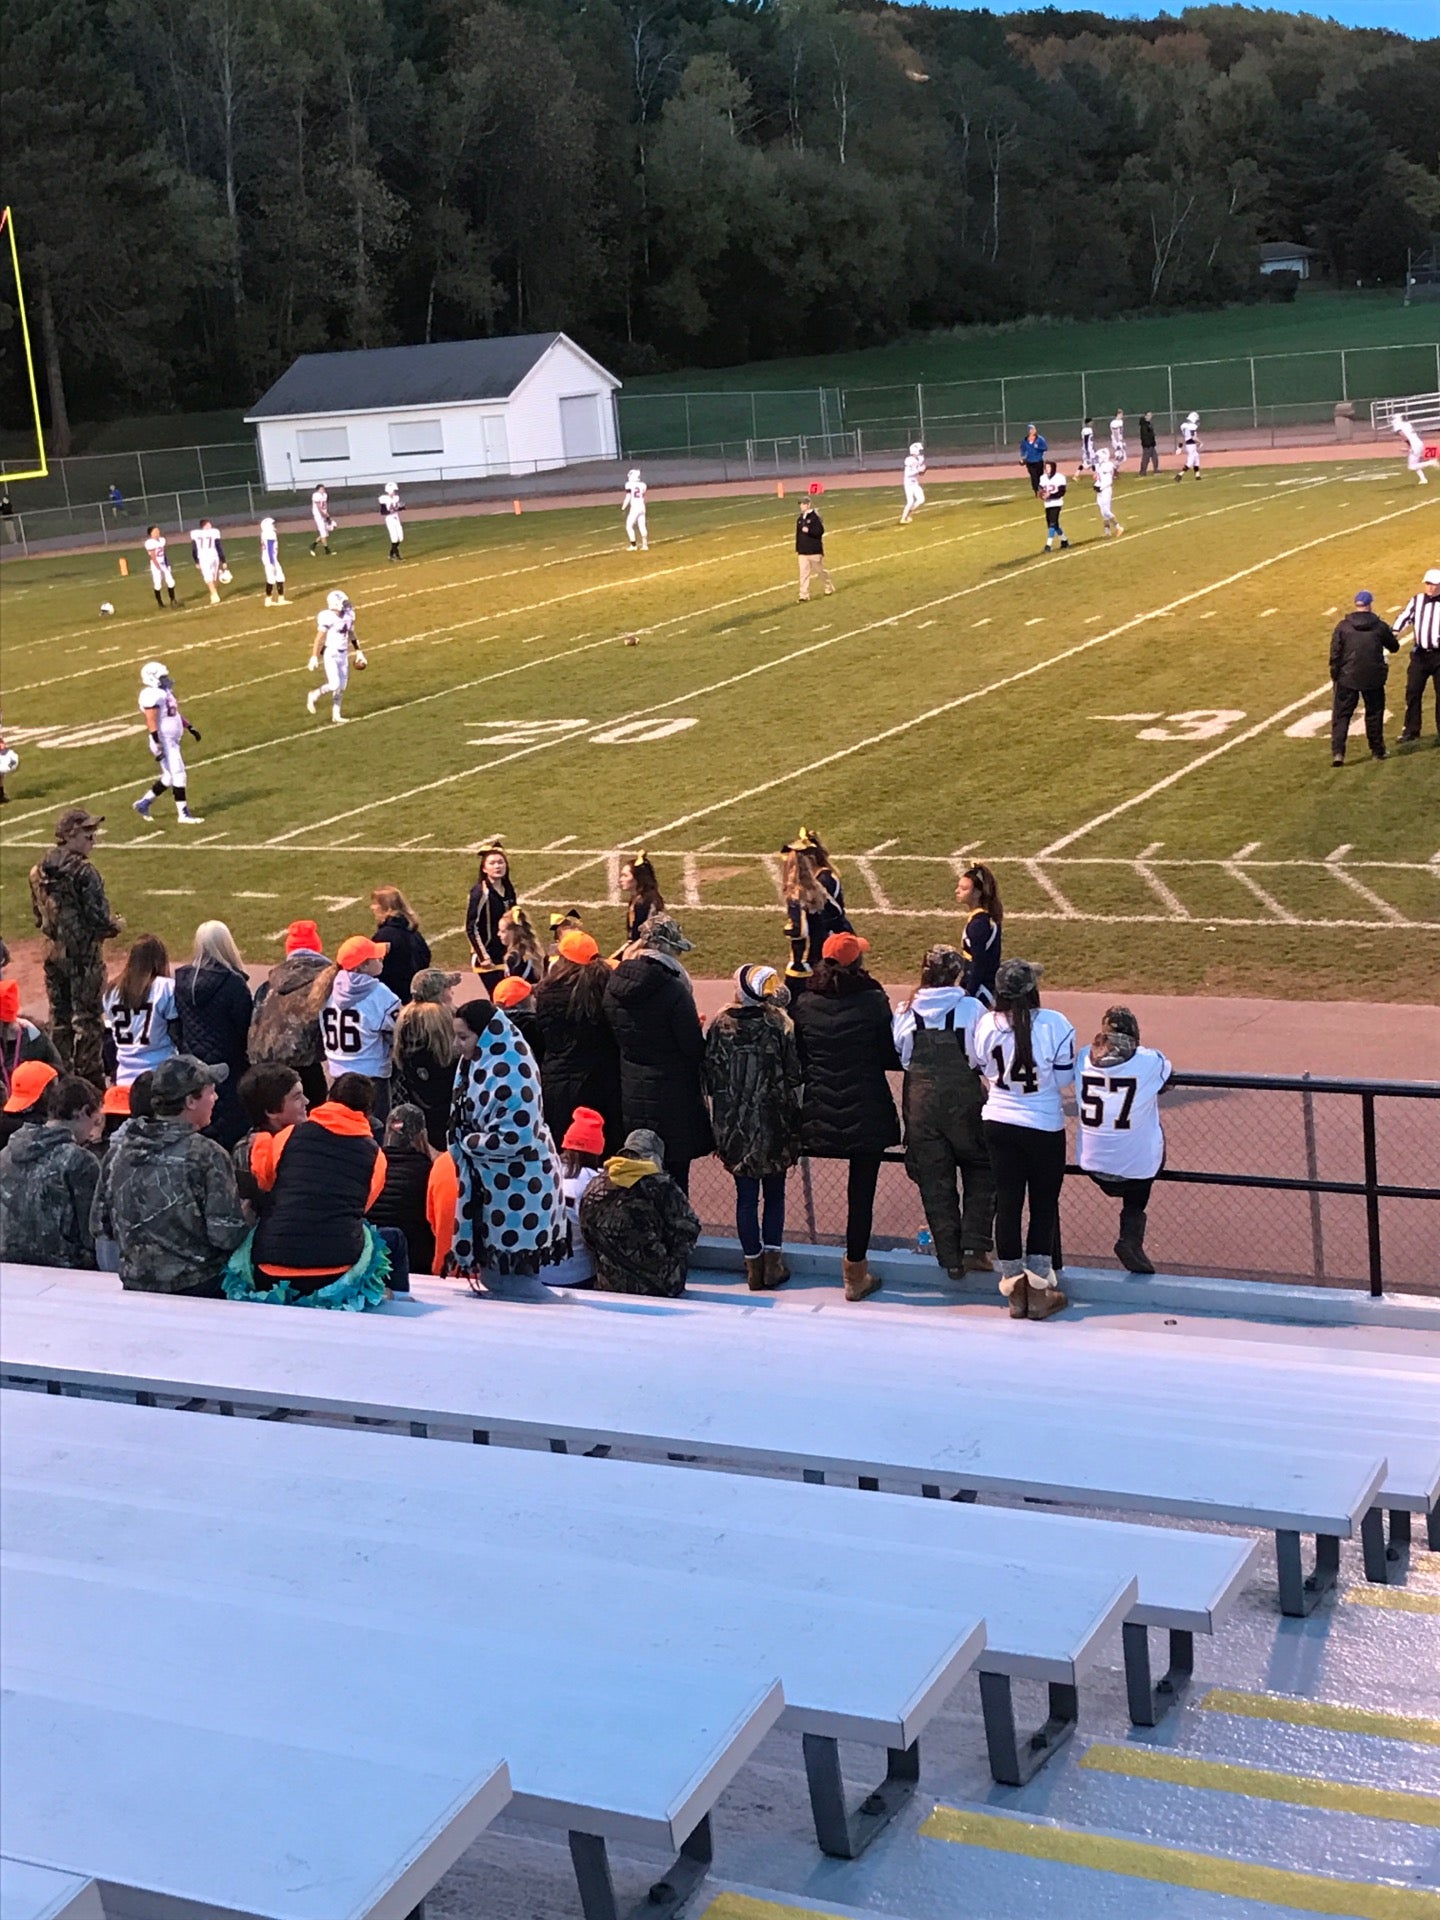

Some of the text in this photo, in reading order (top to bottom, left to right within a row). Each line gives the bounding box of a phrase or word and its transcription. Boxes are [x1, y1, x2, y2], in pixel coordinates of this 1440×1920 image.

[1424, 447, 1437, 458] 20
[634, 487, 640, 498] 2
[113, 1003, 152, 1045] 27
[322, 1007, 362, 1052] 66
[991, 1044, 1039, 1094] 14
[1080, 1074, 1138, 1130] 57
